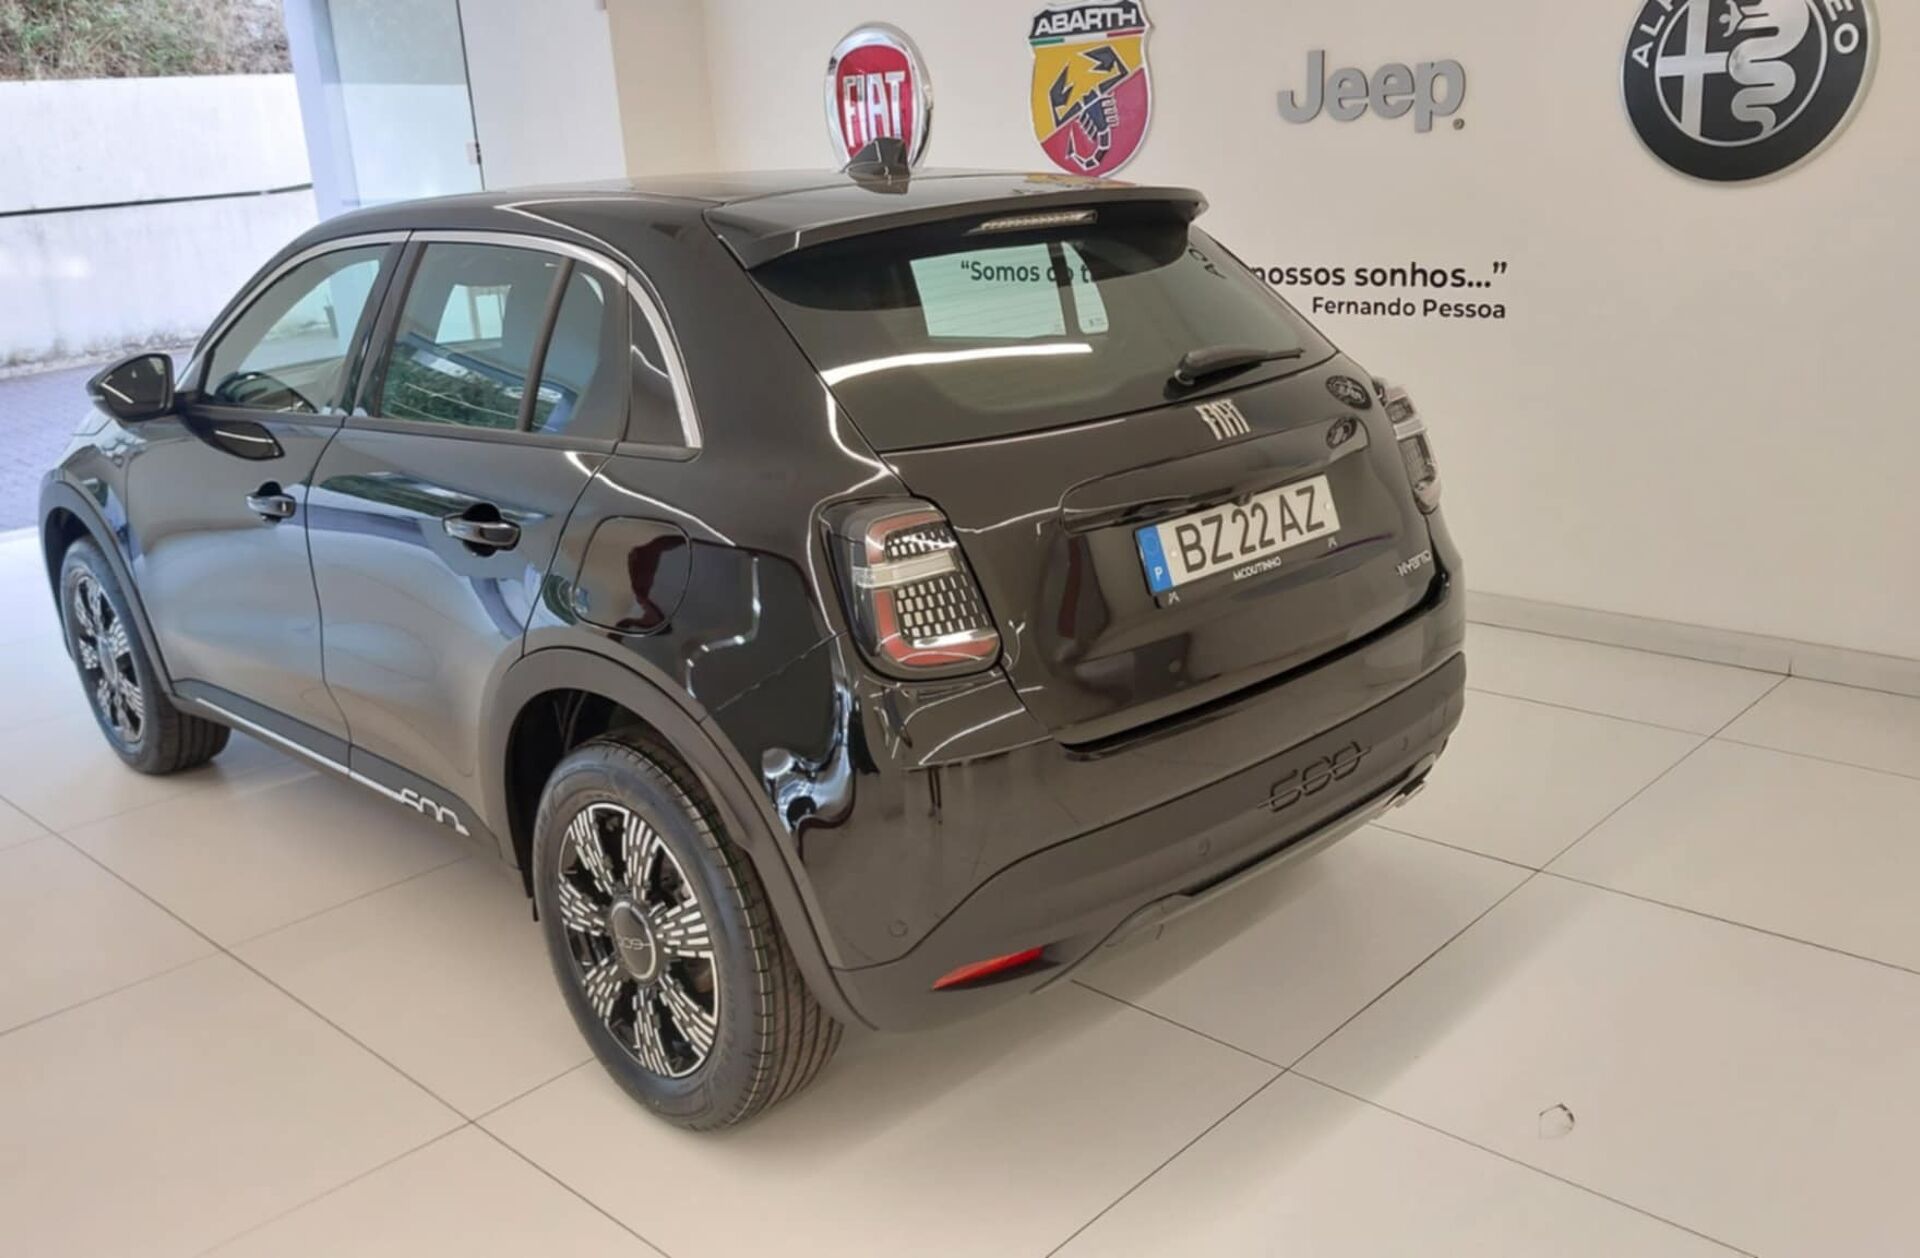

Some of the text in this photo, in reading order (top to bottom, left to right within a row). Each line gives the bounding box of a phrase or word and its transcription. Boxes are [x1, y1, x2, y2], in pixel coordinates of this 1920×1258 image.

[1035, 7, 1137, 36] ABARTH
[843, 70, 905, 147] FIAT
[1277, 50, 1466, 133] Jeep
[1312, 297, 1506, 319] Fernando Pessoa
[1195, 398, 1251, 441] FIAT
[1154, 567, 1164, 582] P
